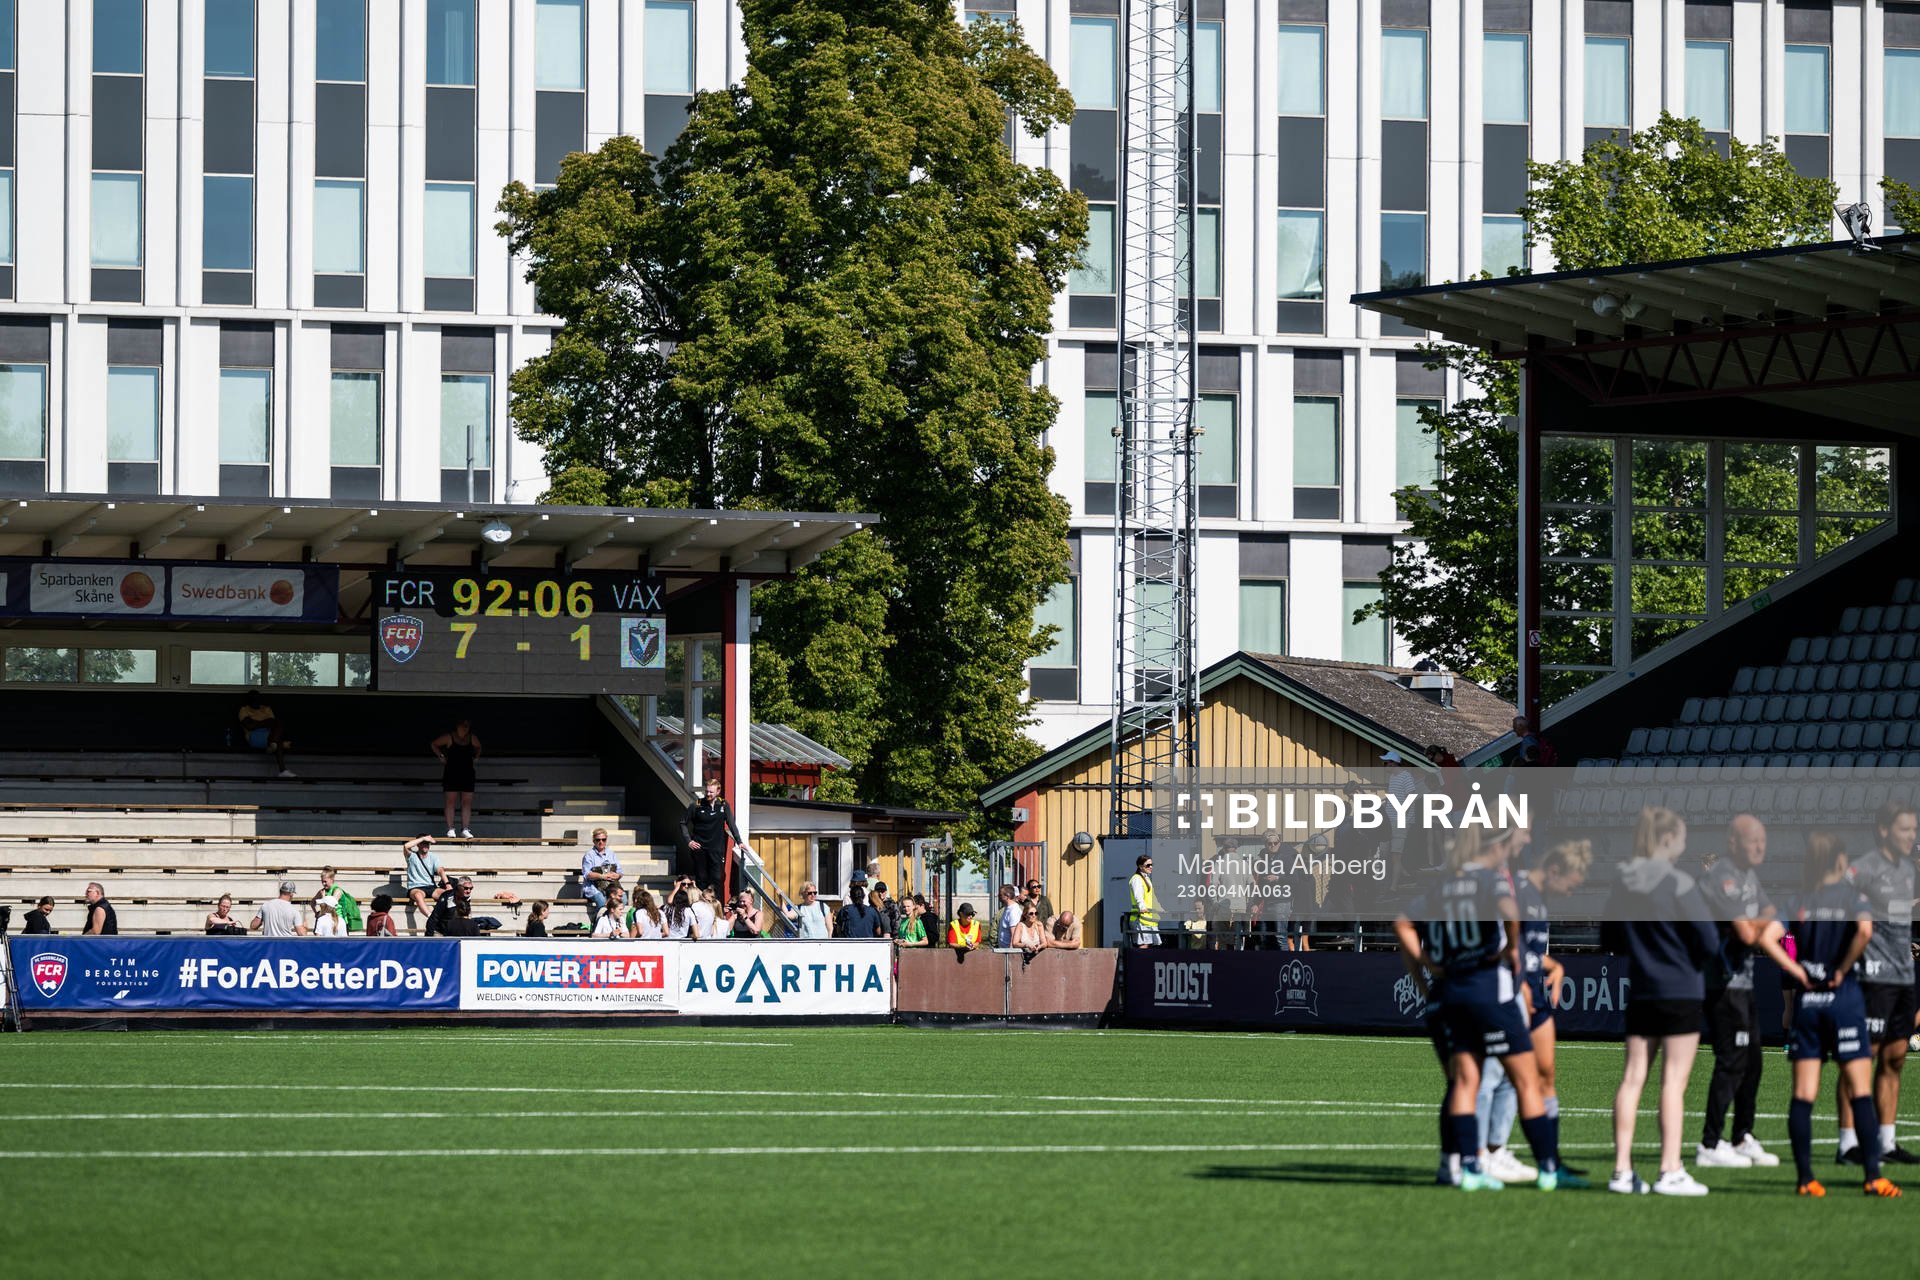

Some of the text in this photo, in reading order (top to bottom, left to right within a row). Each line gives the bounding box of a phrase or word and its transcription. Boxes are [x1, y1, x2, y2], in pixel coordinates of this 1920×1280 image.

[40, 572, 114, 588] Sparbanken
[75, 589, 114, 603] Skåne
[181, 582, 267, 601] Swedbank
[385, 578, 662, 618] FCR 92:06 VÄX
[386, 627, 417, 640] FCR
[450, 622, 478, 659] 7
[570, 624, 591, 661] 1
[36, 964, 62, 976] FCR
[110, 958, 136, 966] TIM
[85, 969, 160, 978] BERGLING
[178, 957, 443, 998] #ForABetterDay
[483, 959, 658, 983] POWER HEAT
[1154, 962, 1213, 1001] BOOST
[1583, 966, 1614, 1011] PÅ
[476, 993, 664, 1002] WELDING CONSTRUCTION MAINTENANCE
